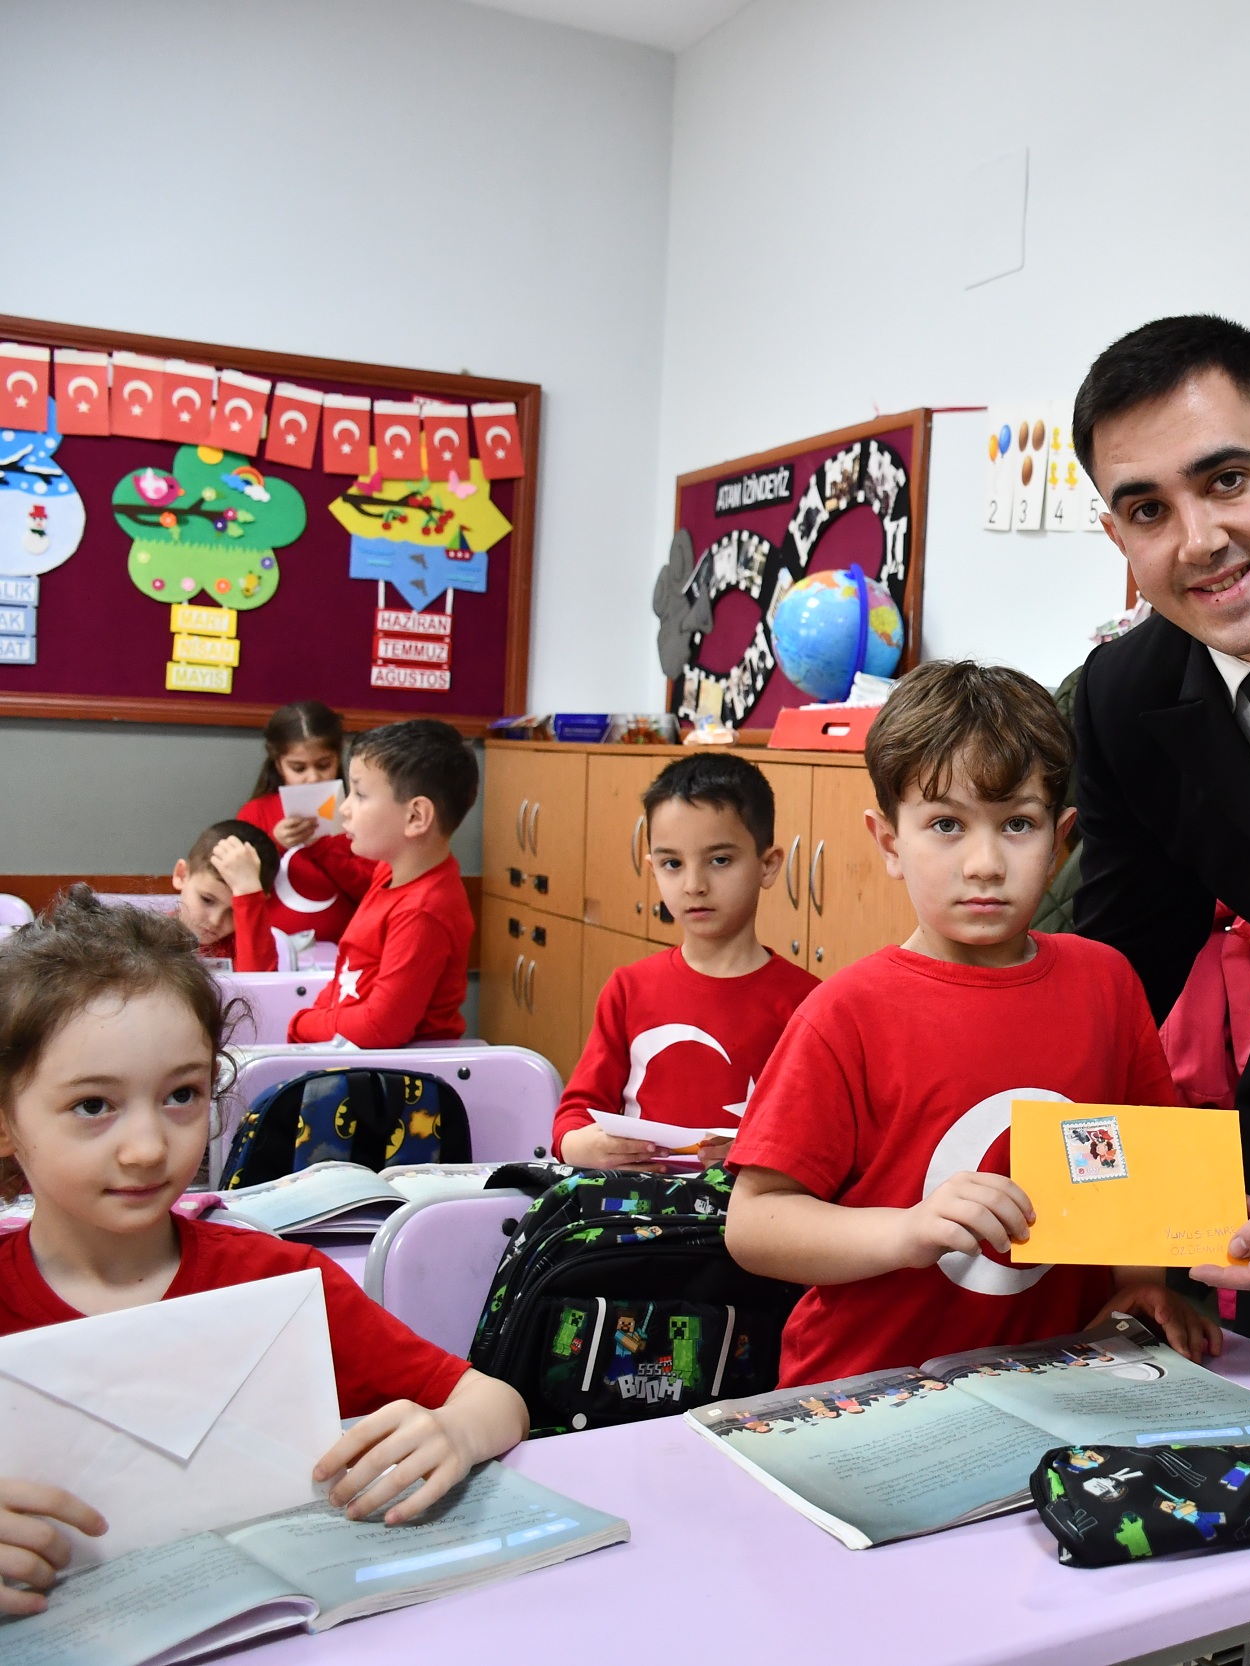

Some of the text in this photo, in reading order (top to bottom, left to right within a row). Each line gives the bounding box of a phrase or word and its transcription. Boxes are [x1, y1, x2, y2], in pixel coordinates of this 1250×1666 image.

[715, 482, 742, 512] ATAM
[988, 500, 998, 524] 2
[1019, 499, 1028, 523] 3
[1054, 501, 1064, 524] 4
[1089, 498, 1099, 524] 5
[0, 581, 32, 599] LIK
[180, 611, 228, 631] MART
[381, 612, 447, 632] HAZİRAN
[180, 636, 233, 661] NİSAN
[383, 642, 446, 660] TEMMUZ
[175, 667, 227, 688] MAYIS
[375, 667, 448, 688] AĞUSTOS
[1164, 1225, 1237, 1240] YUNUS EMRE
[618, 1374, 684, 1405] BOOM
